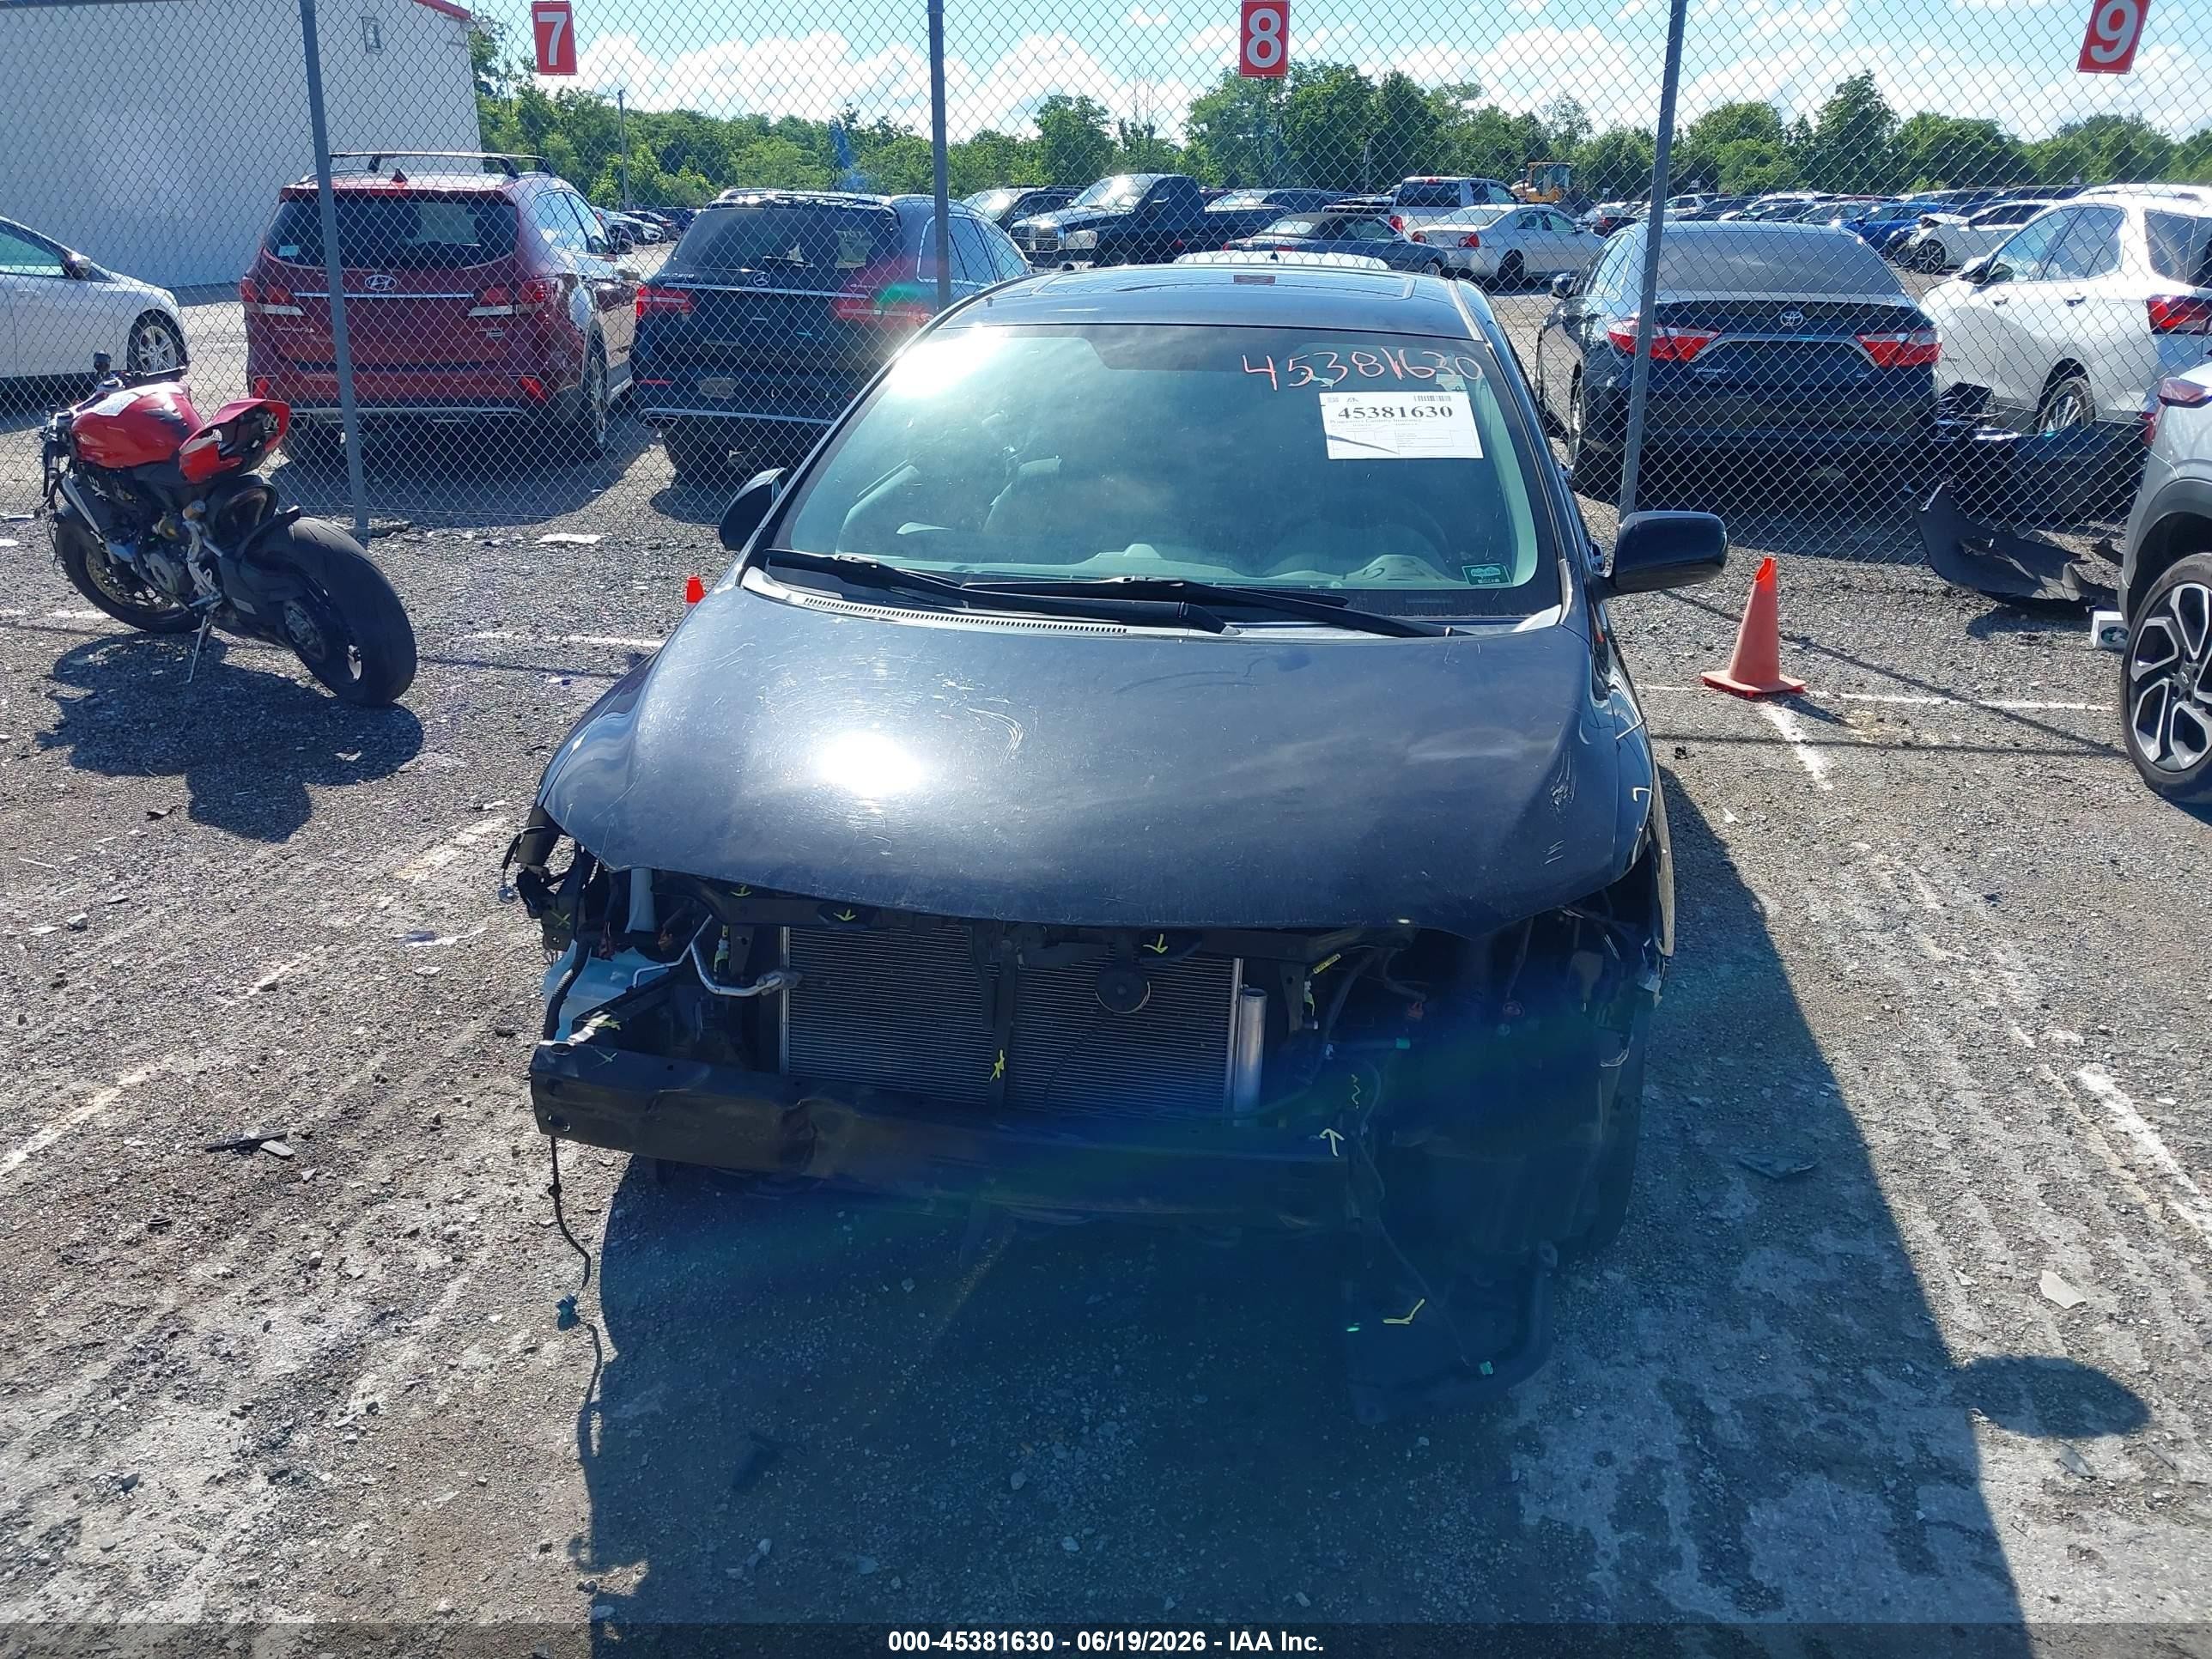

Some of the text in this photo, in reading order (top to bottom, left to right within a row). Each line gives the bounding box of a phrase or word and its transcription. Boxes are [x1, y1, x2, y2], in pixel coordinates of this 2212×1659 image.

[538, 11, 568, 66] 7
[1247, 8, 1282, 68] 8
[2090, 0, 2139, 64] 9
[1242, 347, 1484, 392] 45381630
[1338, 405, 1454, 420] 45381630
